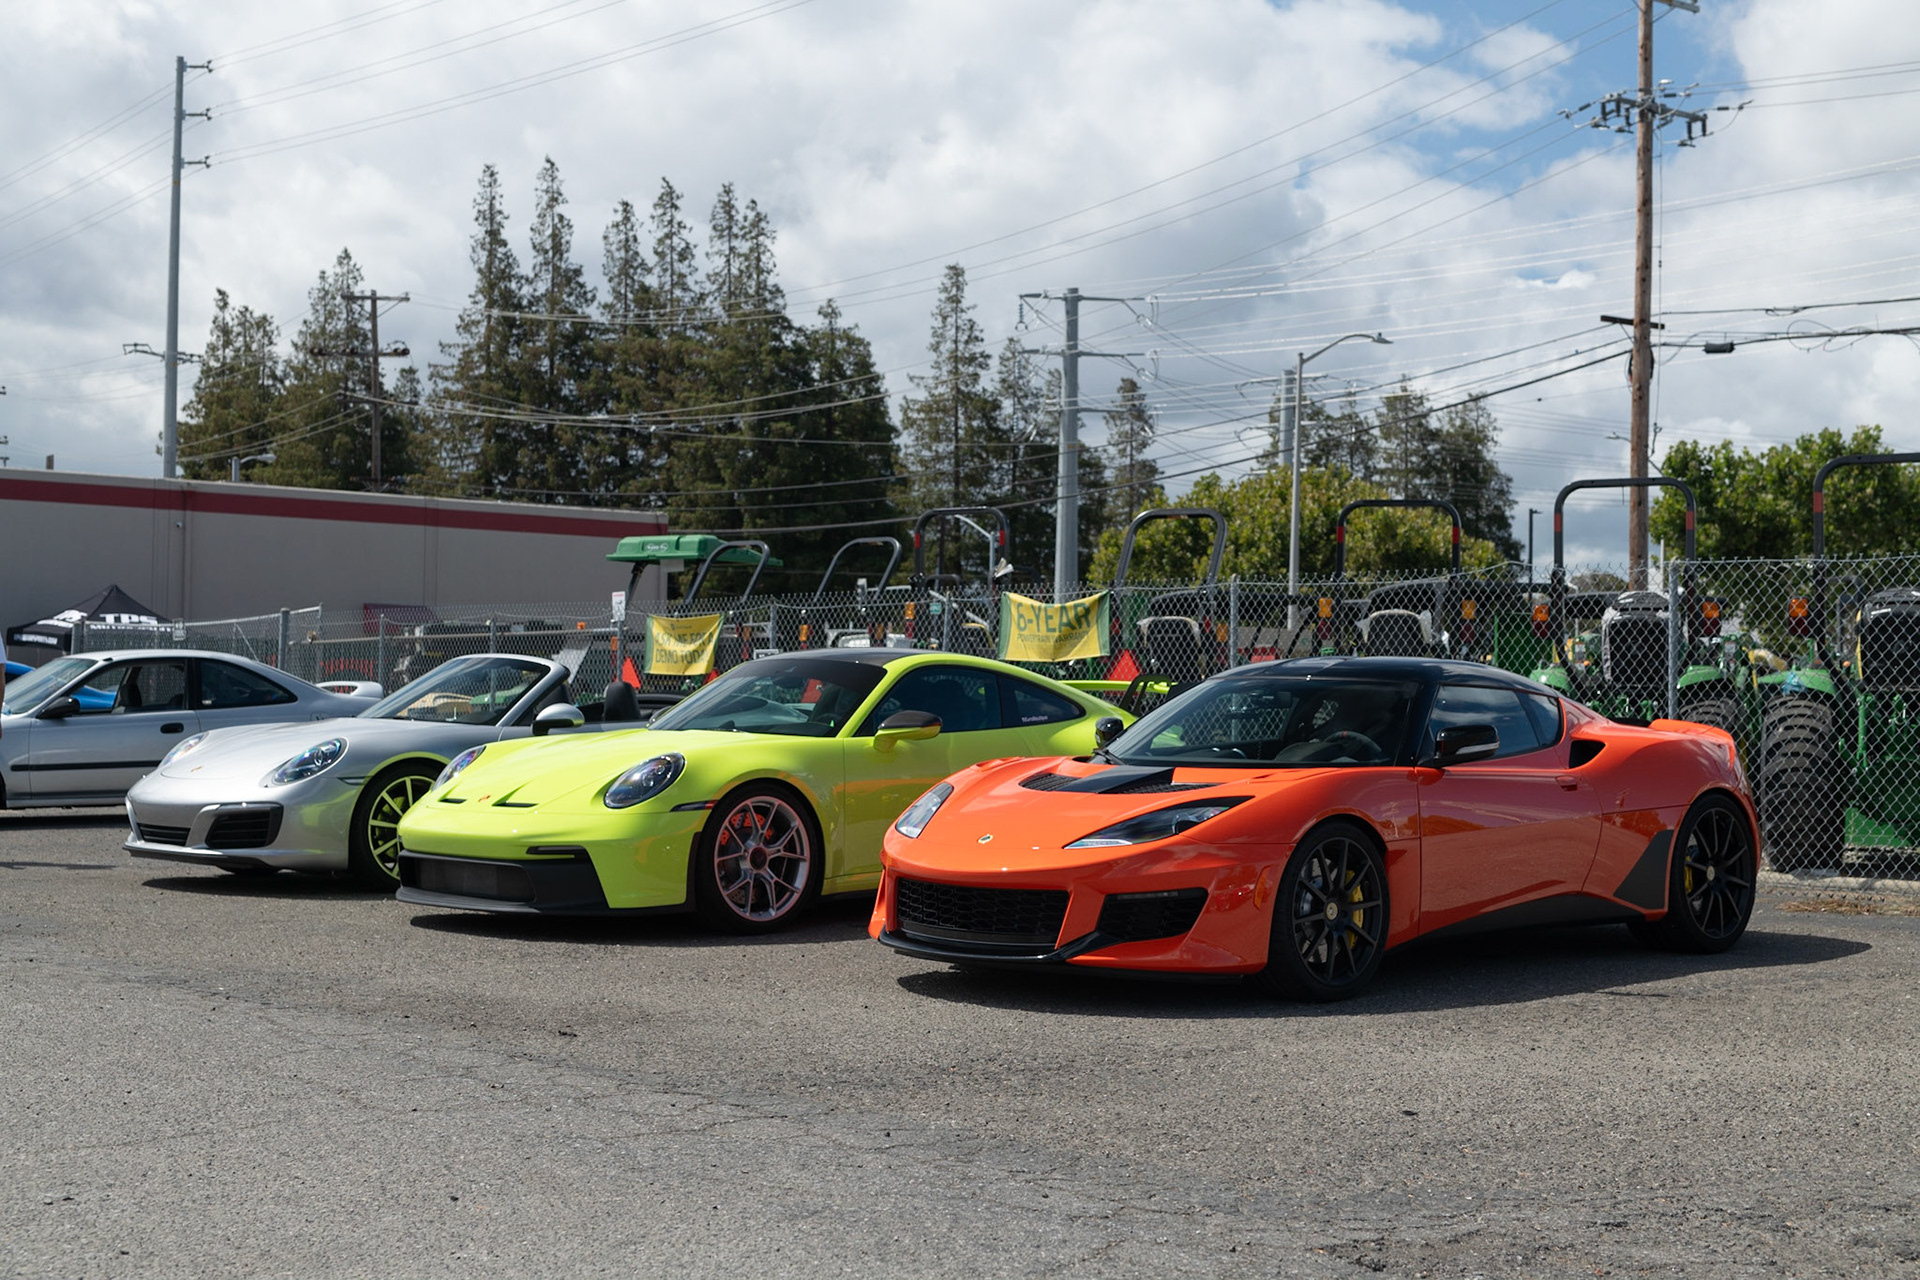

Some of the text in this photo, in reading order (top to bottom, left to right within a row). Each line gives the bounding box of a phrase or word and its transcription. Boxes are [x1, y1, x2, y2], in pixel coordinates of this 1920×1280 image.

[99, 613, 158, 625] TPS
[1016, 602, 1091, 633] 6-YEAR
[655, 648, 708, 664] DEMO TODA
